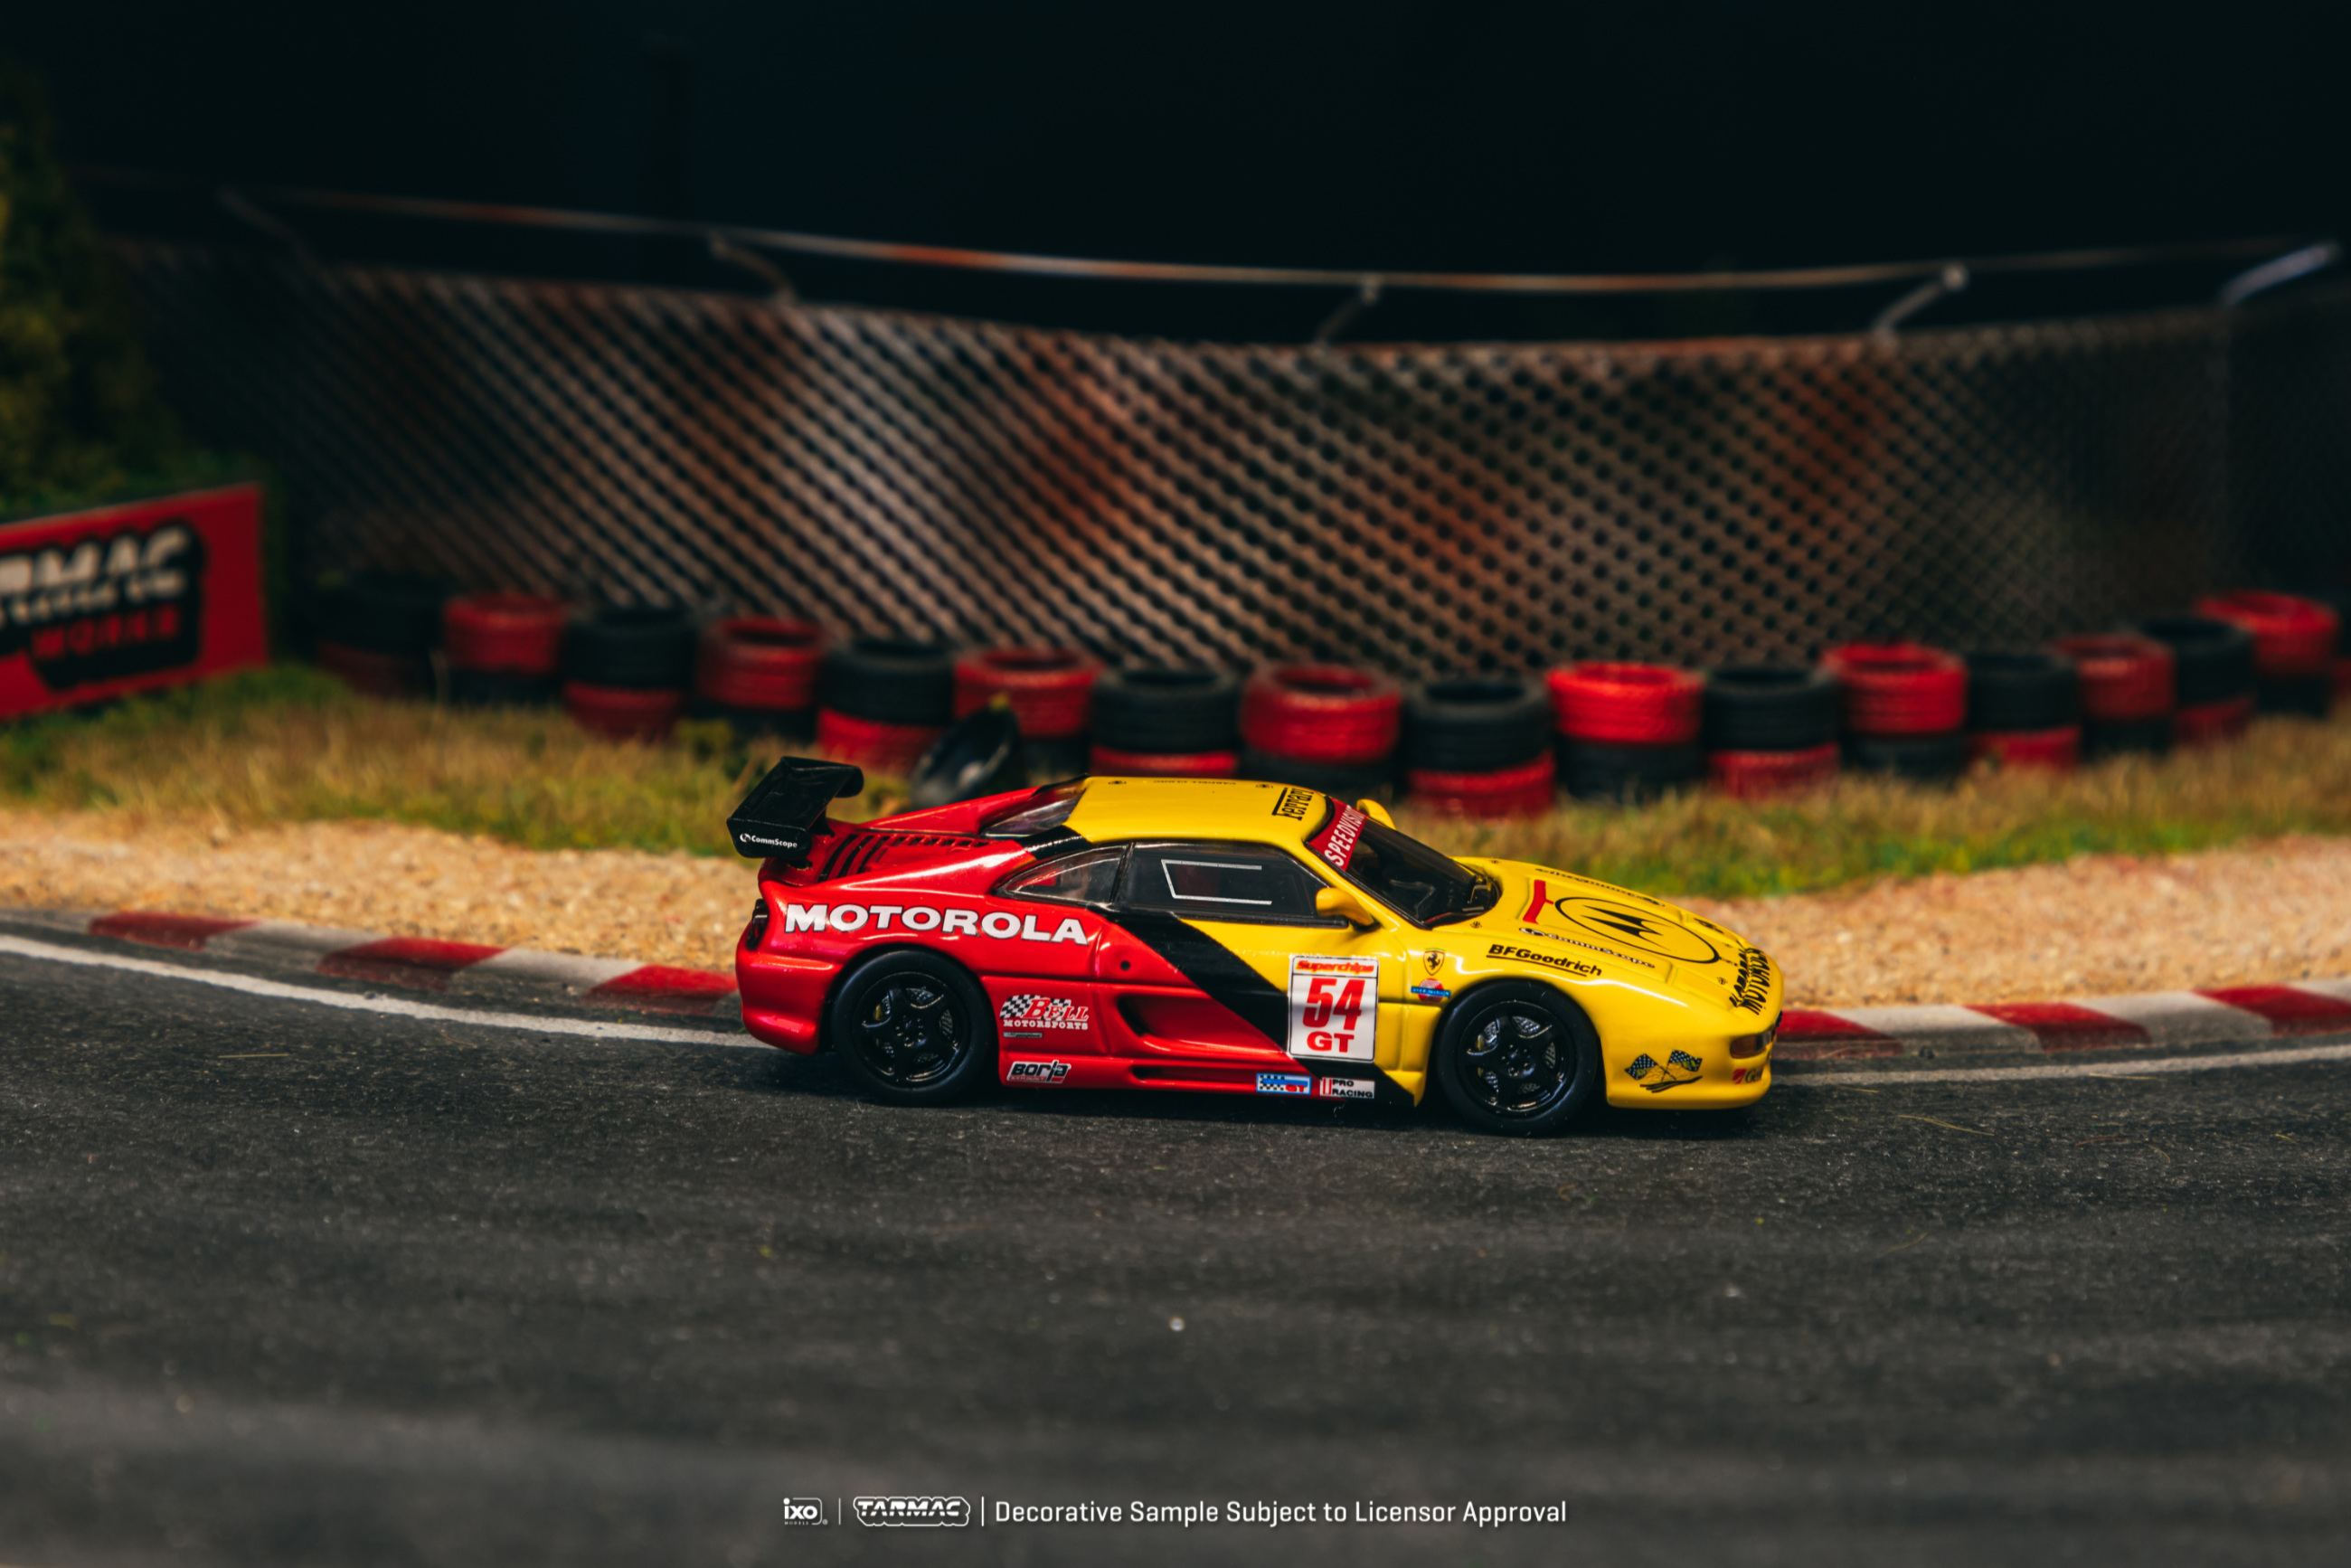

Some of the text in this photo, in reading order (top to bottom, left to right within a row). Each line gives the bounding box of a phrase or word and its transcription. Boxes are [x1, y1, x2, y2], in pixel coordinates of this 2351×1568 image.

[751, 835, 798, 849] CommScope
[785, 903, 1090, 945] MOTOROLA
[1295, 959, 1374, 976] Superchips
[1487, 943, 1602, 977] BFGoodrich
[1302, 978, 1365, 1031] 54
[1003, 1019, 1089, 1031] MOTORSPORTS
[1307, 1031, 1355, 1053] GT
[1332, 1079, 1355, 1088] PRO
[1332, 1088, 1373, 1098] RACING
